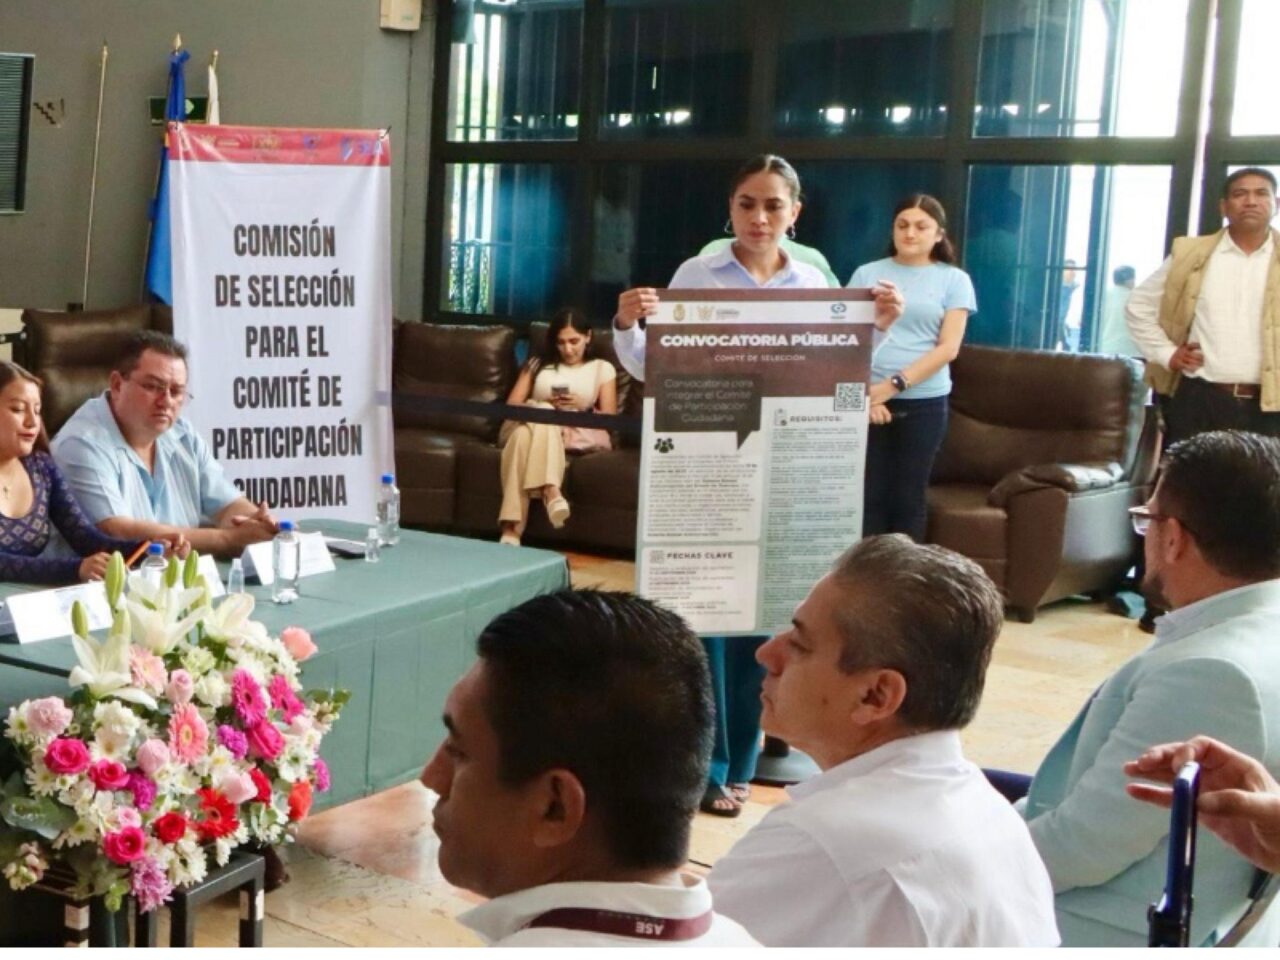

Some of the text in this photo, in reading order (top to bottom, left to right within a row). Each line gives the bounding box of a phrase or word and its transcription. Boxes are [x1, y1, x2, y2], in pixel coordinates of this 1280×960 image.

[234, 218, 335, 257] COMISIÓN
[215, 269, 355, 307] DE SELECCIÓN
[246, 325, 329, 358] PARA EL
[660, 331, 859, 347] CONVOCATORIA PÚBLICA
[233, 369, 342, 409] COMITÉ DE
[212, 418, 362, 459] PARTICIPACIÓN
[636, 921, 664, 935] ASE
